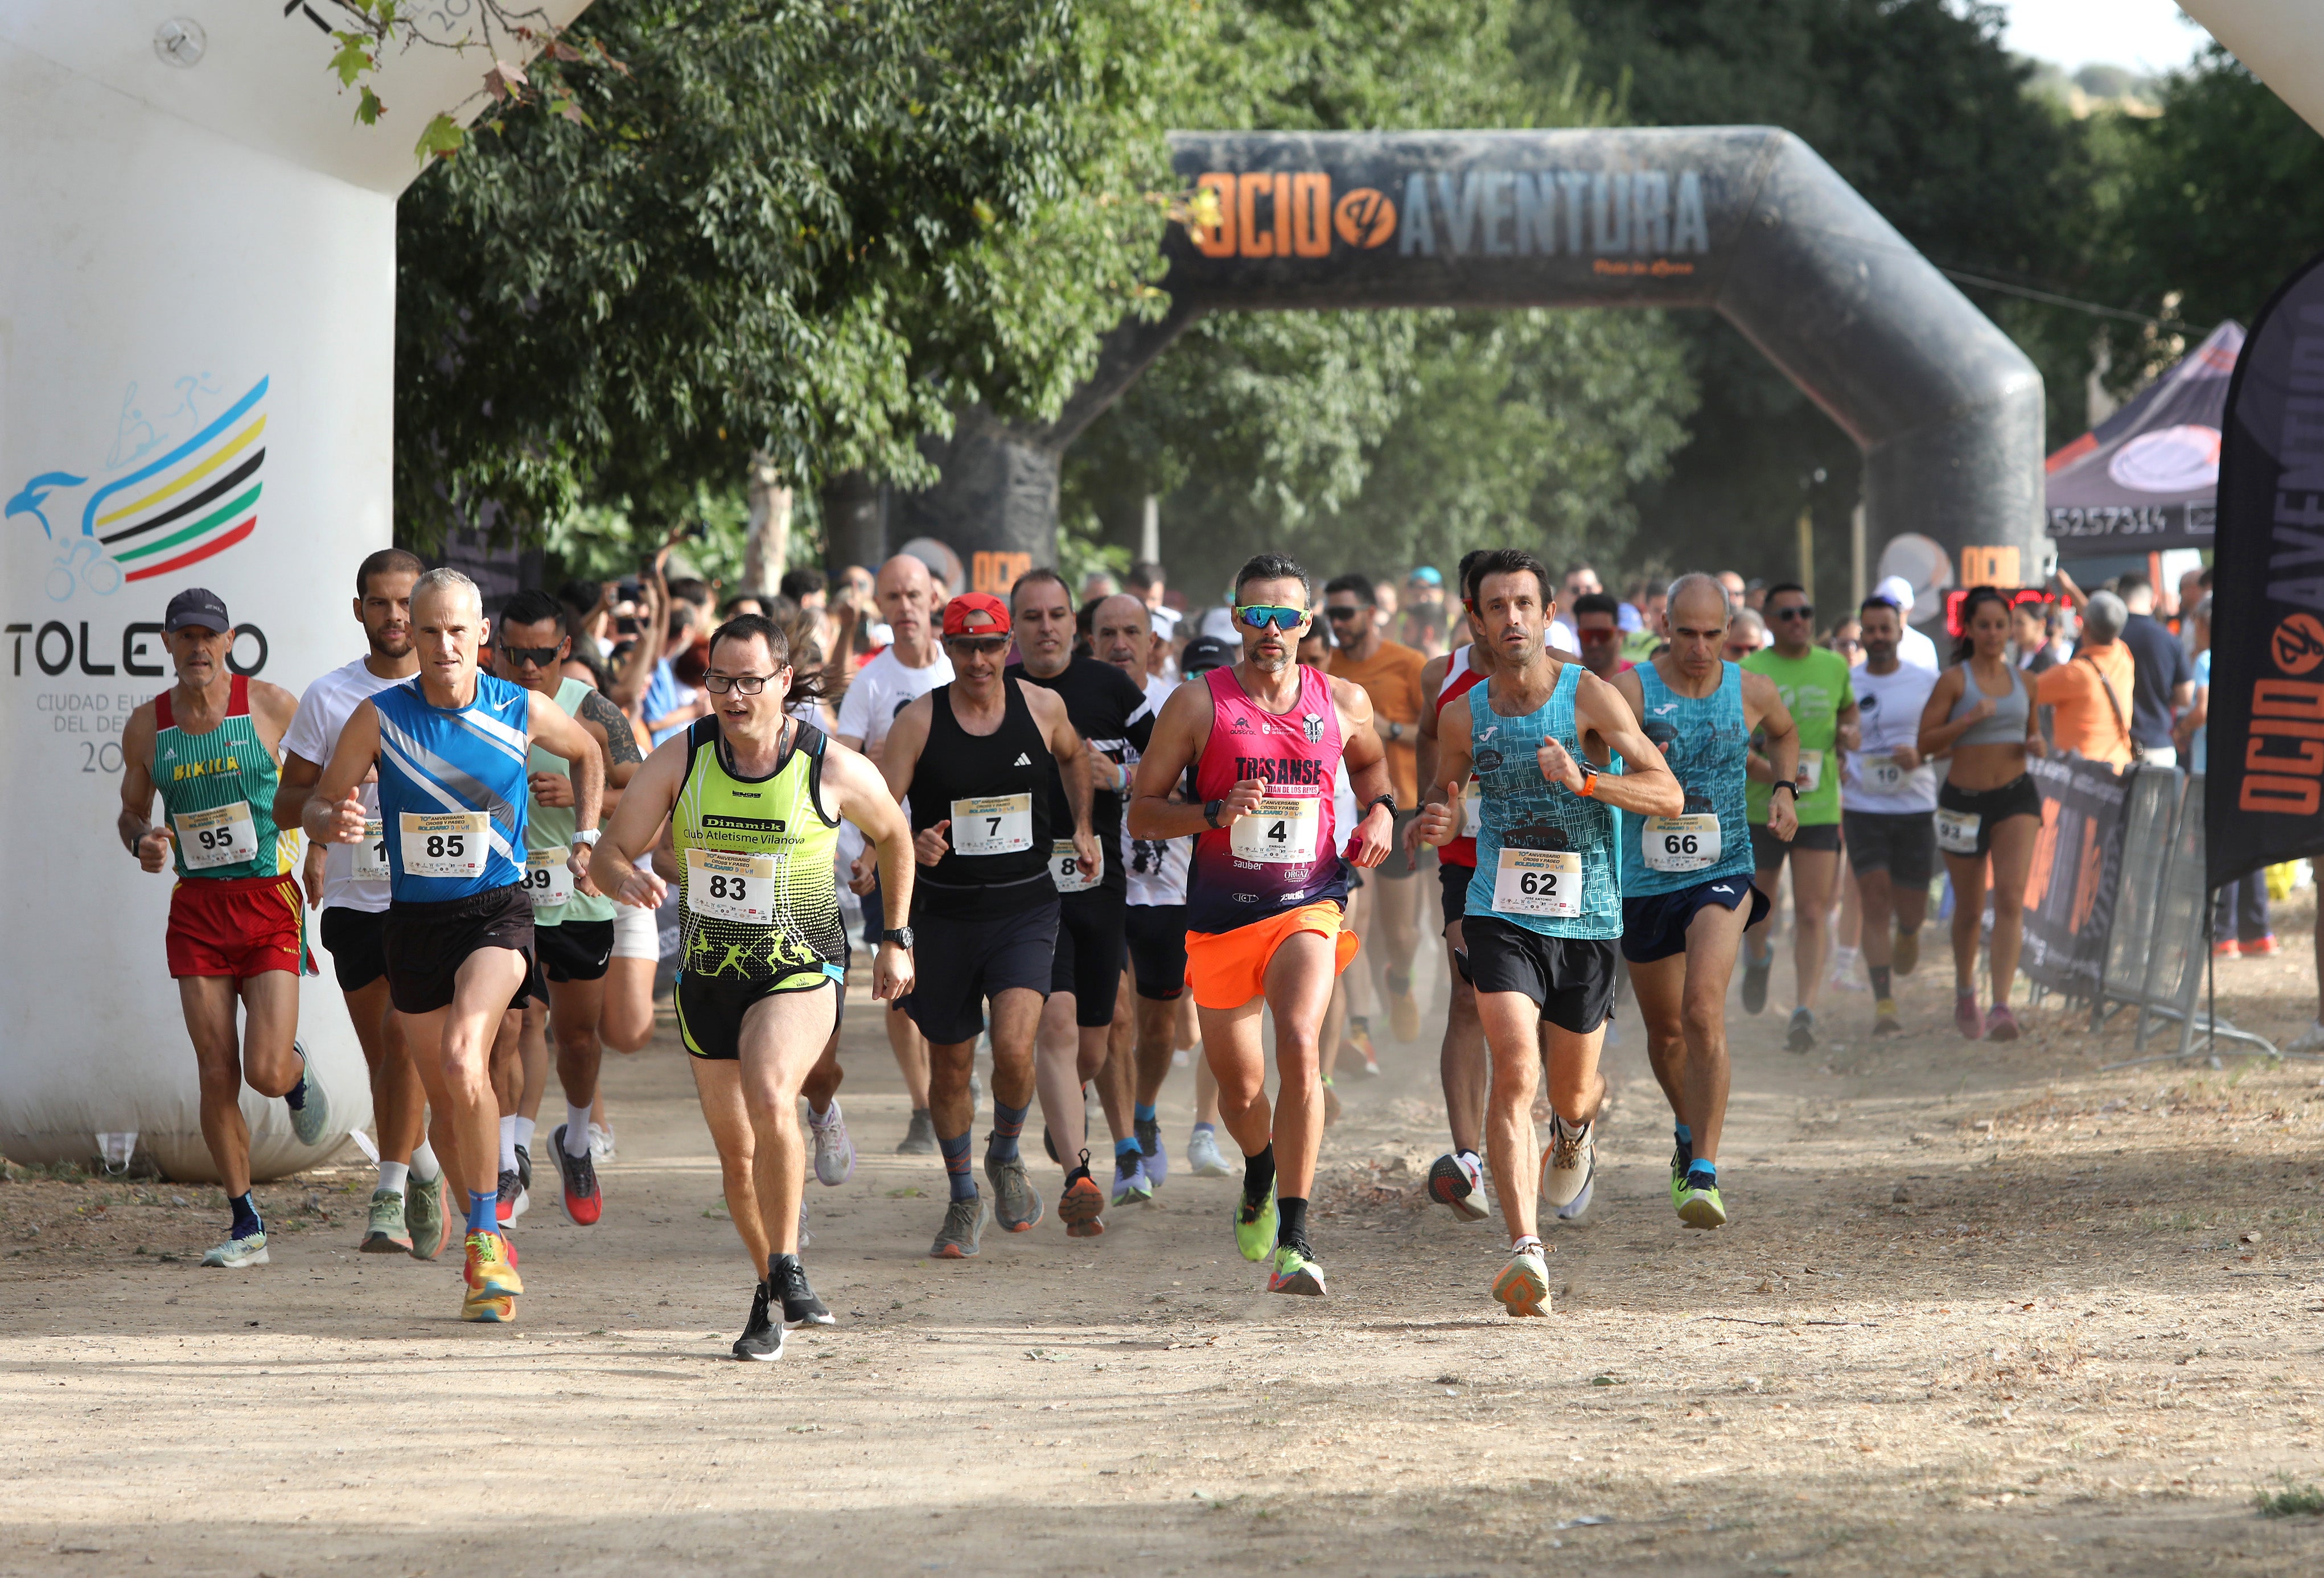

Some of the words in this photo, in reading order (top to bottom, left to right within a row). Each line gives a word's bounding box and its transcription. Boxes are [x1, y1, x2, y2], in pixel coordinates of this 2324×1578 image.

[1198, 172, 1331, 258] OCIO
[1398, 171, 1709, 257] AVENTURA
[2045, 505, 2167, 537] 5257314
[5, 621, 268, 677] TOLEO
[36, 693, 109, 711] CIUDAD
[55, 715, 89, 732] DEL
[97, 716, 125, 732] DE
[2239, 678, 2324, 815] OCIO
[174, 756, 240, 781] BIKILA
[706, 818, 781, 831] Dinami-k
[986, 817, 1002, 837] 7
[1268, 821, 1286, 843] 4
[199, 827, 233, 849] 95
[426, 835, 464, 858] 85
[684, 829, 703, 839] Club
[706, 831, 758, 843] Atletisme
[761, 834, 805, 844] Vilanova
[1665, 835, 1698, 854] 66
[373, 841, 386, 862] 1
[1061, 858, 1075, 876] 8
[1233, 860, 1264, 871] sauber
[1284, 870, 1309, 879] ORGAZ
[710, 875, 747, 901] 83
[1520, 872, 1557, 896] 62
